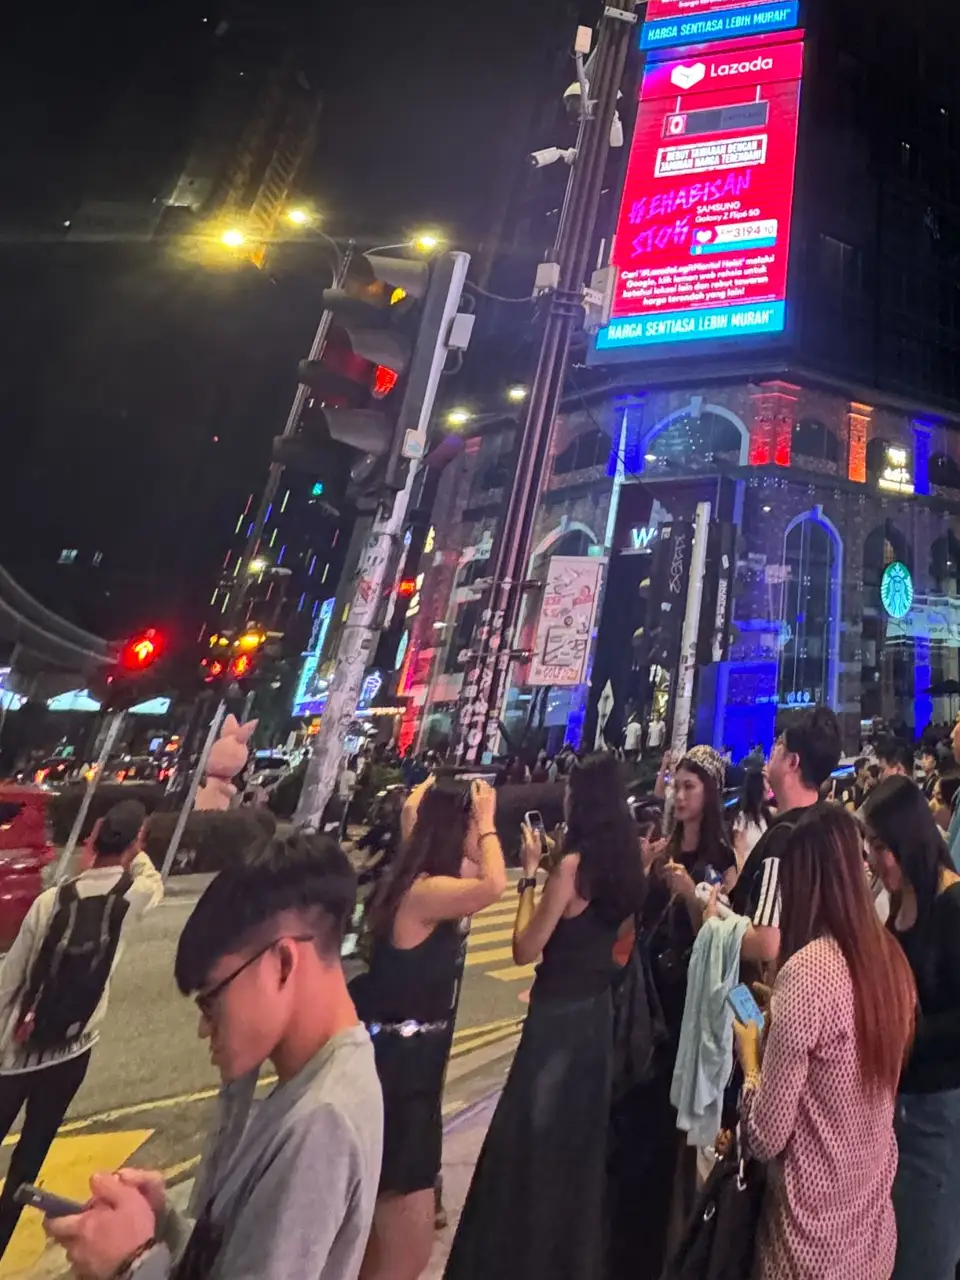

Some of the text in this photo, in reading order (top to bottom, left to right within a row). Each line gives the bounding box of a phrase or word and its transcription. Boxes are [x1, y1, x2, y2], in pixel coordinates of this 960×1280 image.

[680, 19, 724, 36] SENTIASA
[725, 15, 751, 29] LEBIH
[710, 56, 773, 77] Lazada
[696, 201, 741, 213] SAMSUNG
[607, 323, 643, 340] HARGA
[645, 319, 695, 336] SENTIASA
[698, 314, 728, 331] LEBIH
